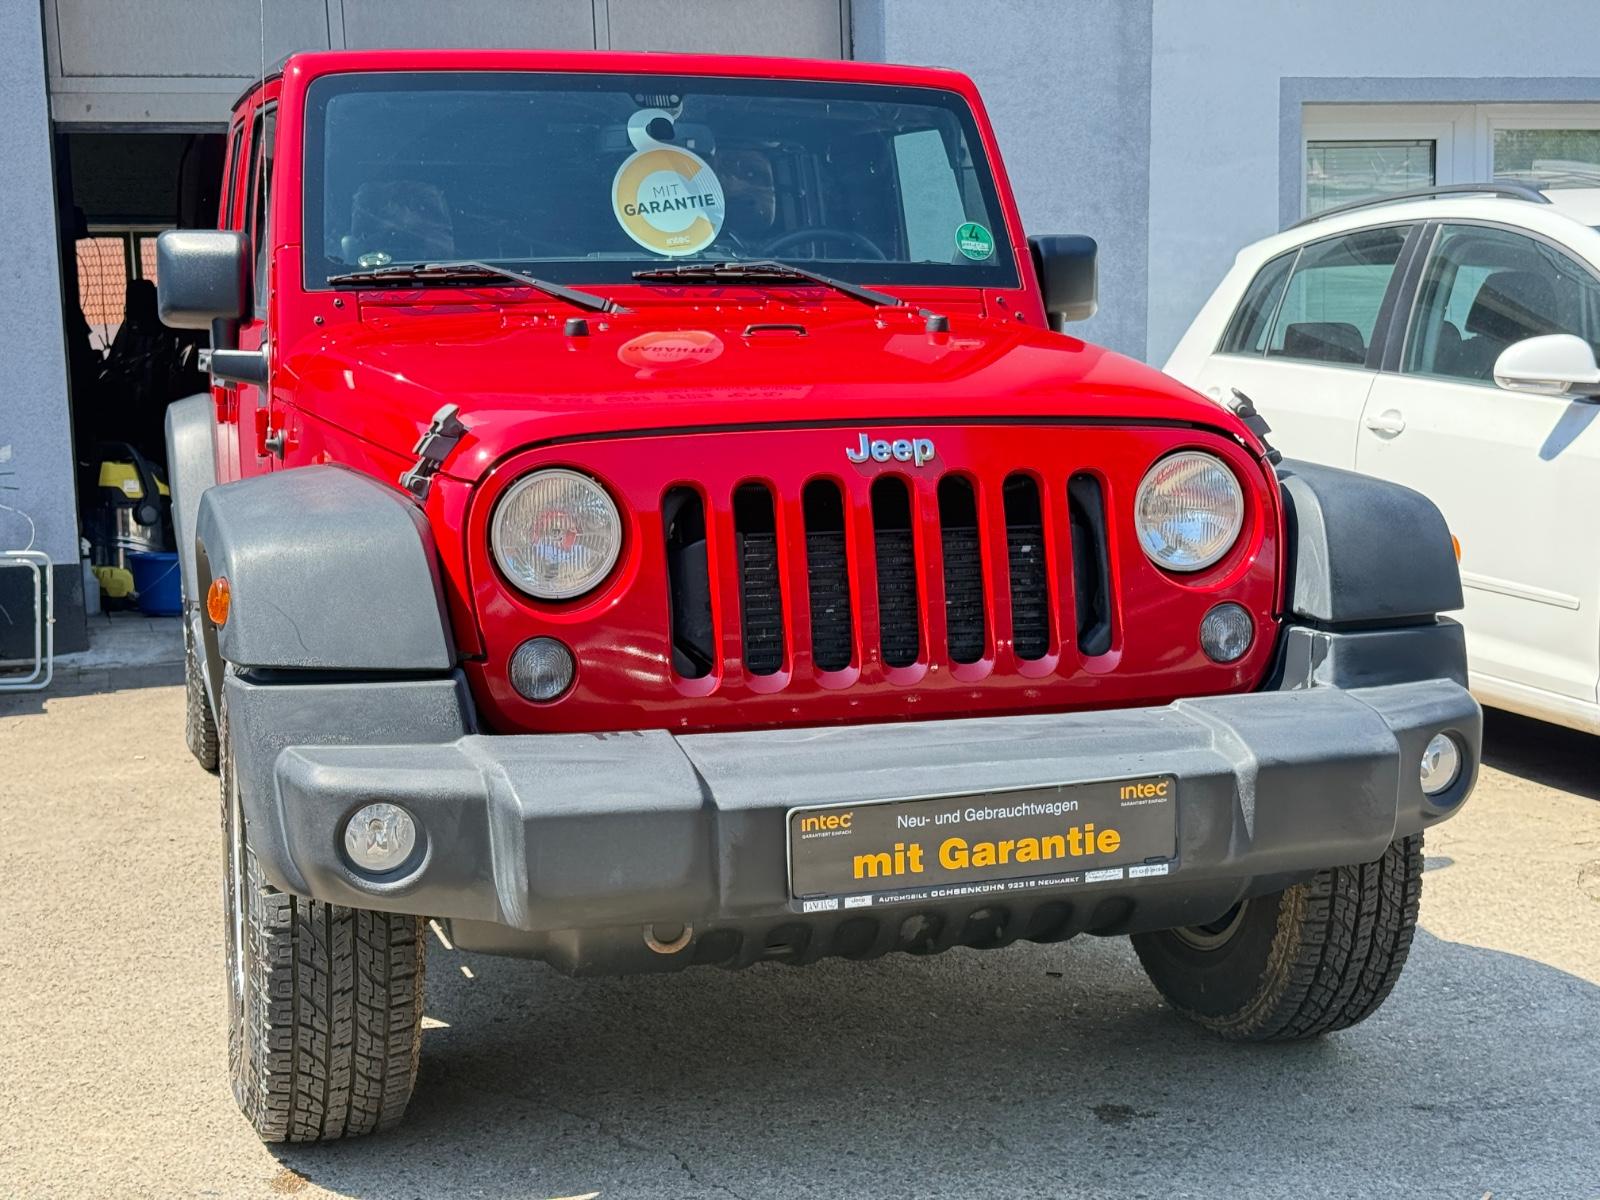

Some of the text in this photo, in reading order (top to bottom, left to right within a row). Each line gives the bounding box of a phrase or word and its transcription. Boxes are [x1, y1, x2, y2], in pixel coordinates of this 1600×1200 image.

[652, 184, 679, 198] MIT
[624, 193, 716, 216] GARANTIE
[969, 225, 980, 241] 4
[845, 432, 935, 467] Jeep
[1120, 781, 1169, 800] intec
[801, 812, 853, 832] intec
[897, 800, 1079, 829] Neu- und Gebrauchtwagen
[853, 822, 1121, 880] mit Garantie
[1038, 876, 1081, 887] NEUMARKT
